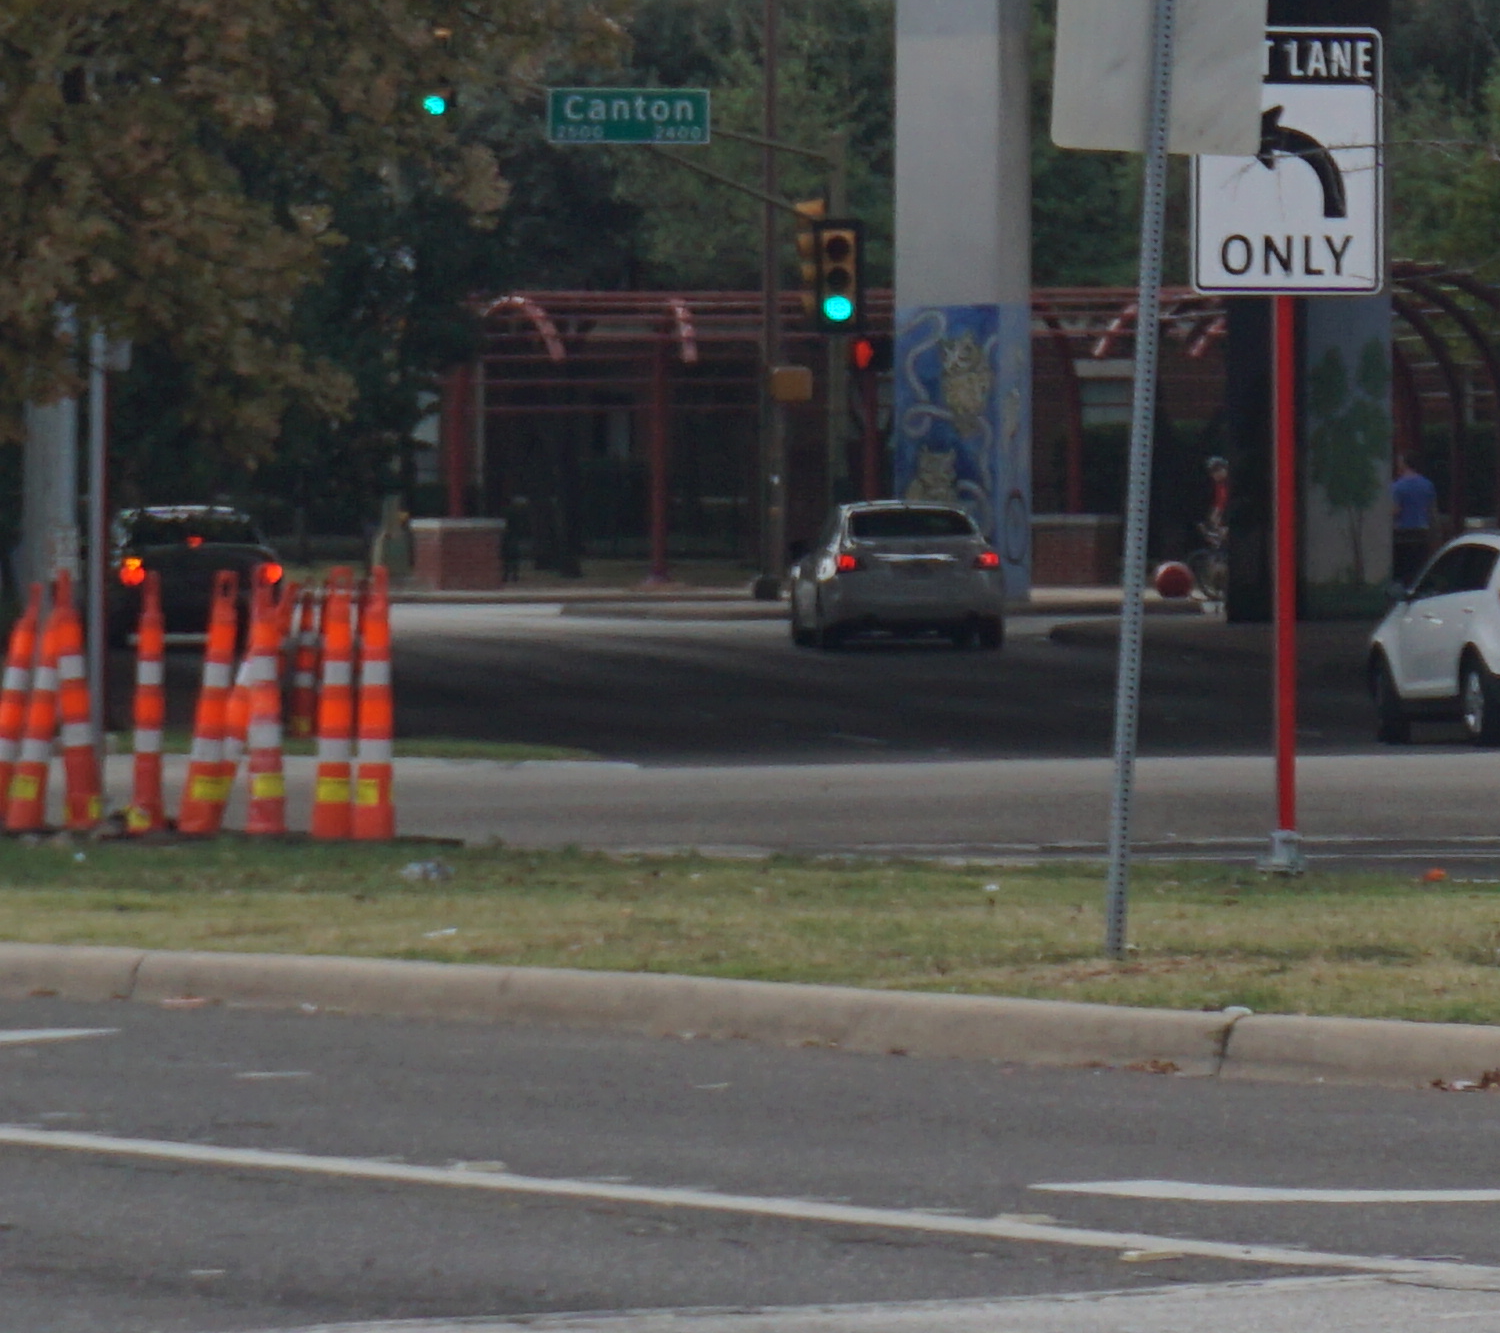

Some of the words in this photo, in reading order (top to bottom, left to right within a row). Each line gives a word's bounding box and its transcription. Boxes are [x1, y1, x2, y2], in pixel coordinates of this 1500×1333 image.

[1282, 40, 1373, 77] LANE
[563, 94, 694, 122] Canton
[1221, 233, 1353, 276] ONLY
